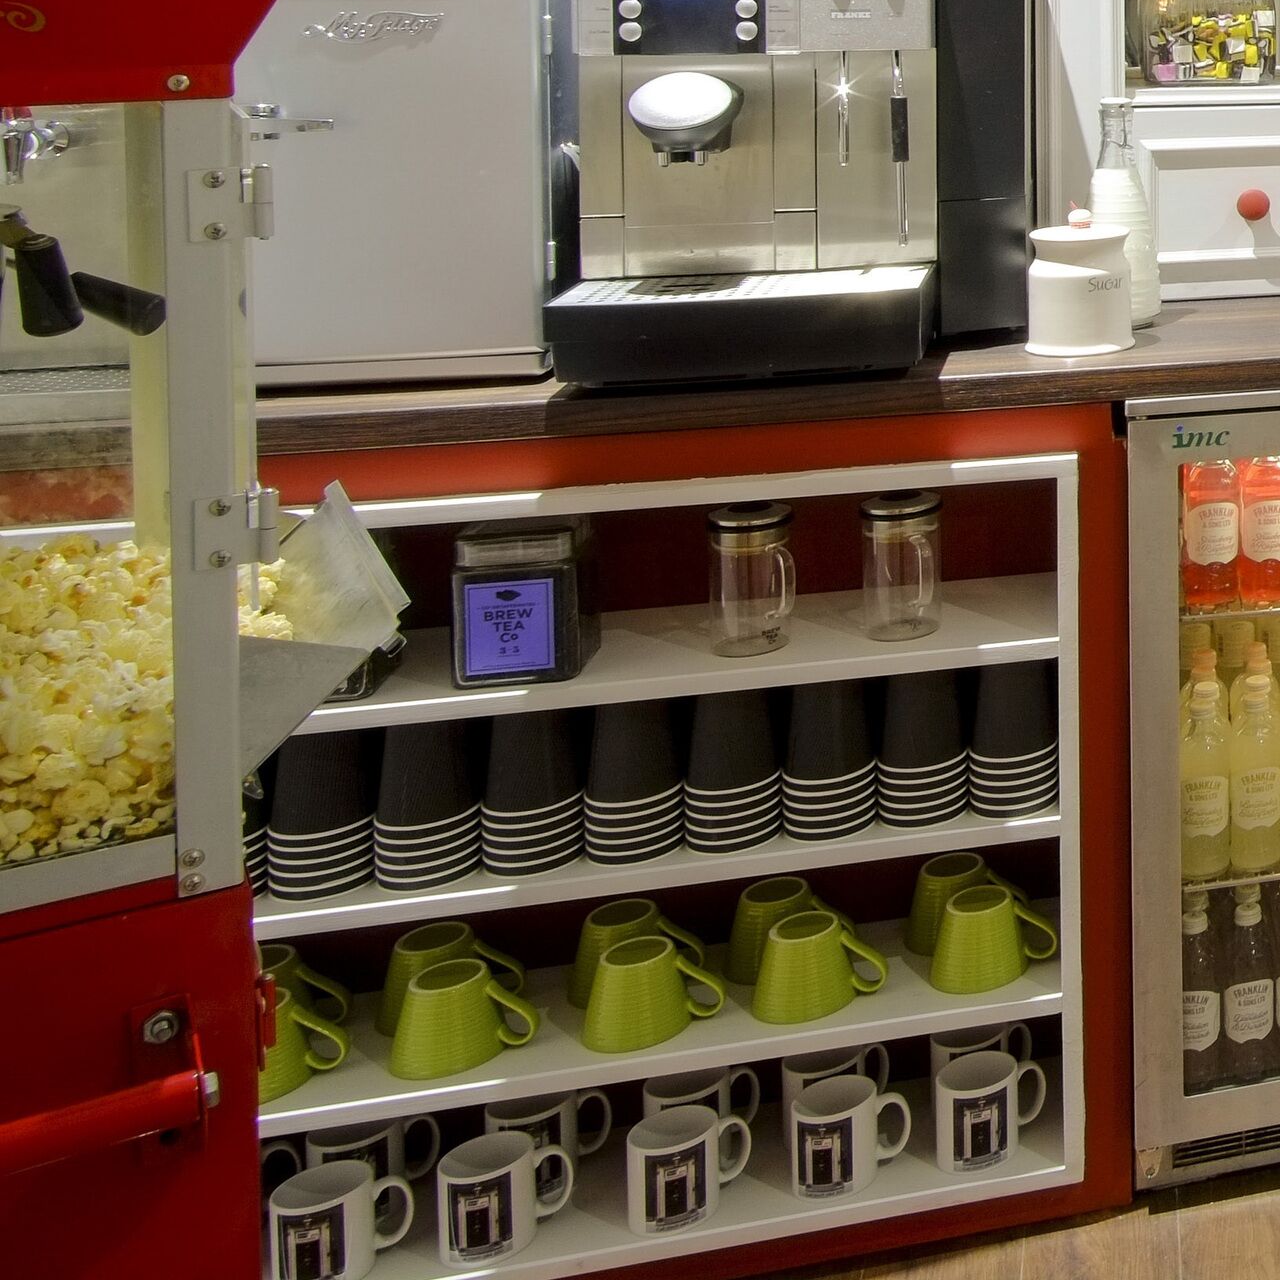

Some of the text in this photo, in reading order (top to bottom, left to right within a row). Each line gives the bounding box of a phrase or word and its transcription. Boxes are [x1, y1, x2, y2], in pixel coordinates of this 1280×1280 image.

[831, 11, 871, 19] FRANKE
[1172, 425, 1230, 448] imc
[1200, 507, 1234, 520] FRANKLIN
[483, 608, 533, 622] BREW
[492, 621, 525, 632] TEA
[500, 632, 519, 642] Co
[1233, 984, 1268, 998] FRANKLIN
[1183, 995, 1210, 1005] ANKLIN
